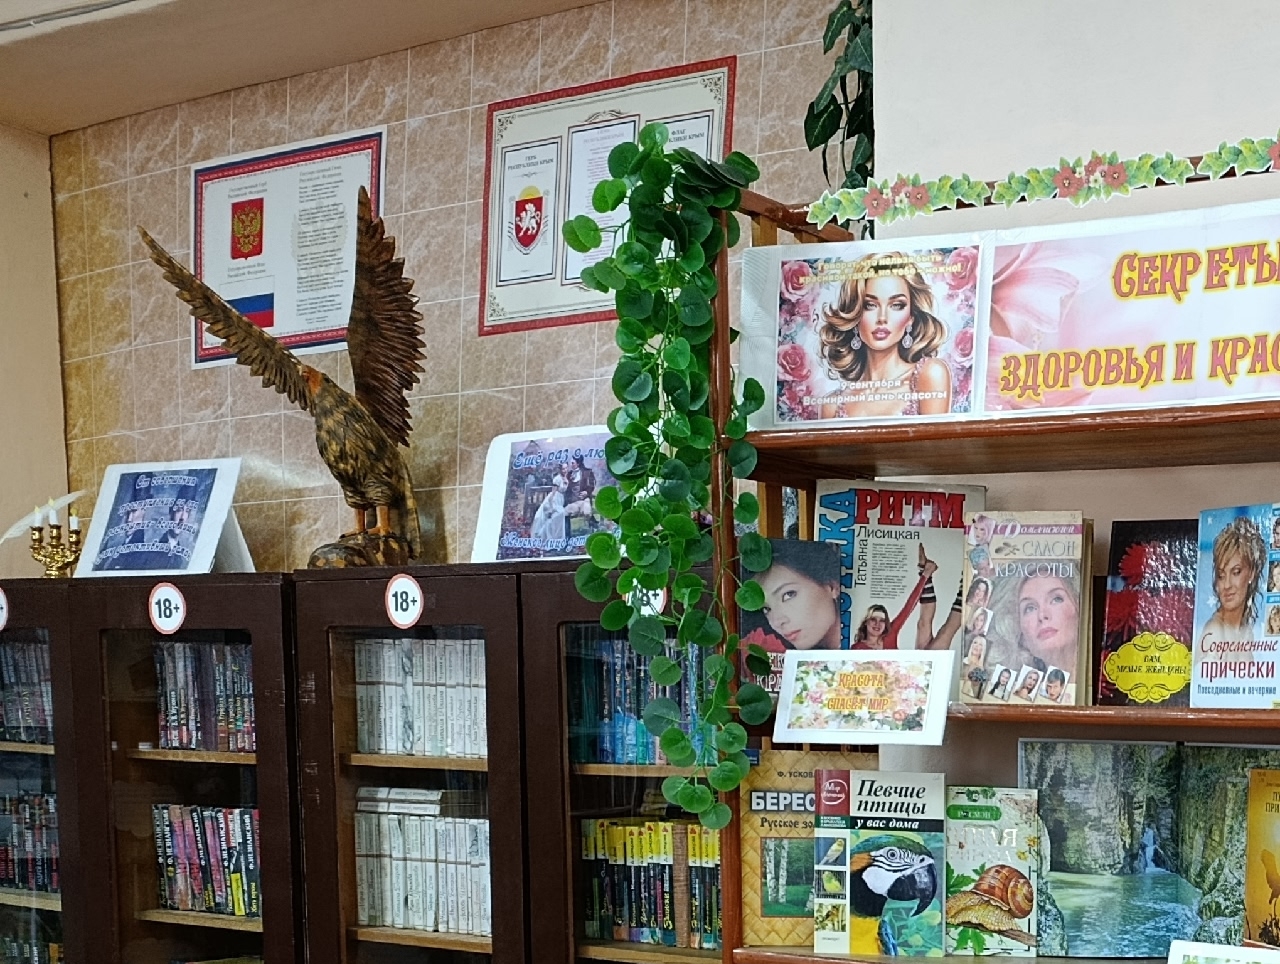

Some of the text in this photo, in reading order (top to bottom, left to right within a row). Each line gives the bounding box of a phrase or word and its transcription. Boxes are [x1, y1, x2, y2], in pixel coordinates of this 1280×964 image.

[1000, 344, 1165, 397] ЗДОРОВЬЯ
[1173, 339, 1194, 379] И
[841, 380, 901, 390] 9 сентября
[803, 391, 947, 405] Всемирный день красоты
[514, 448, 568, 469] Ещё раз
[855, 489, 966, 529] РИТМ
[856, 525, 920, 541] Лисицкая
[1022, 540, 1075, 557] САЛОН
[854, 539, 869, 588] Татьяна
[994, 562, 1075, 579] КРАСОТЫ
[155, 598, 181, 619] 18+
[391, 592, 417, 612] 18+
[1200, 632, 1279, 653] Современные
[1201, 659, 1275, 682] прически
[838, 672, 885, 688] КРАСОТА
[827, 697, 889, 711] СПАСЁТ МИР
[858, 780, 926, 799] Певчие
[857, 799, 926, 816] птицы
[760, 817, 800, 830] Русское
[855, 820, 863, 829] у
[890, 820, 919, 829] дома
